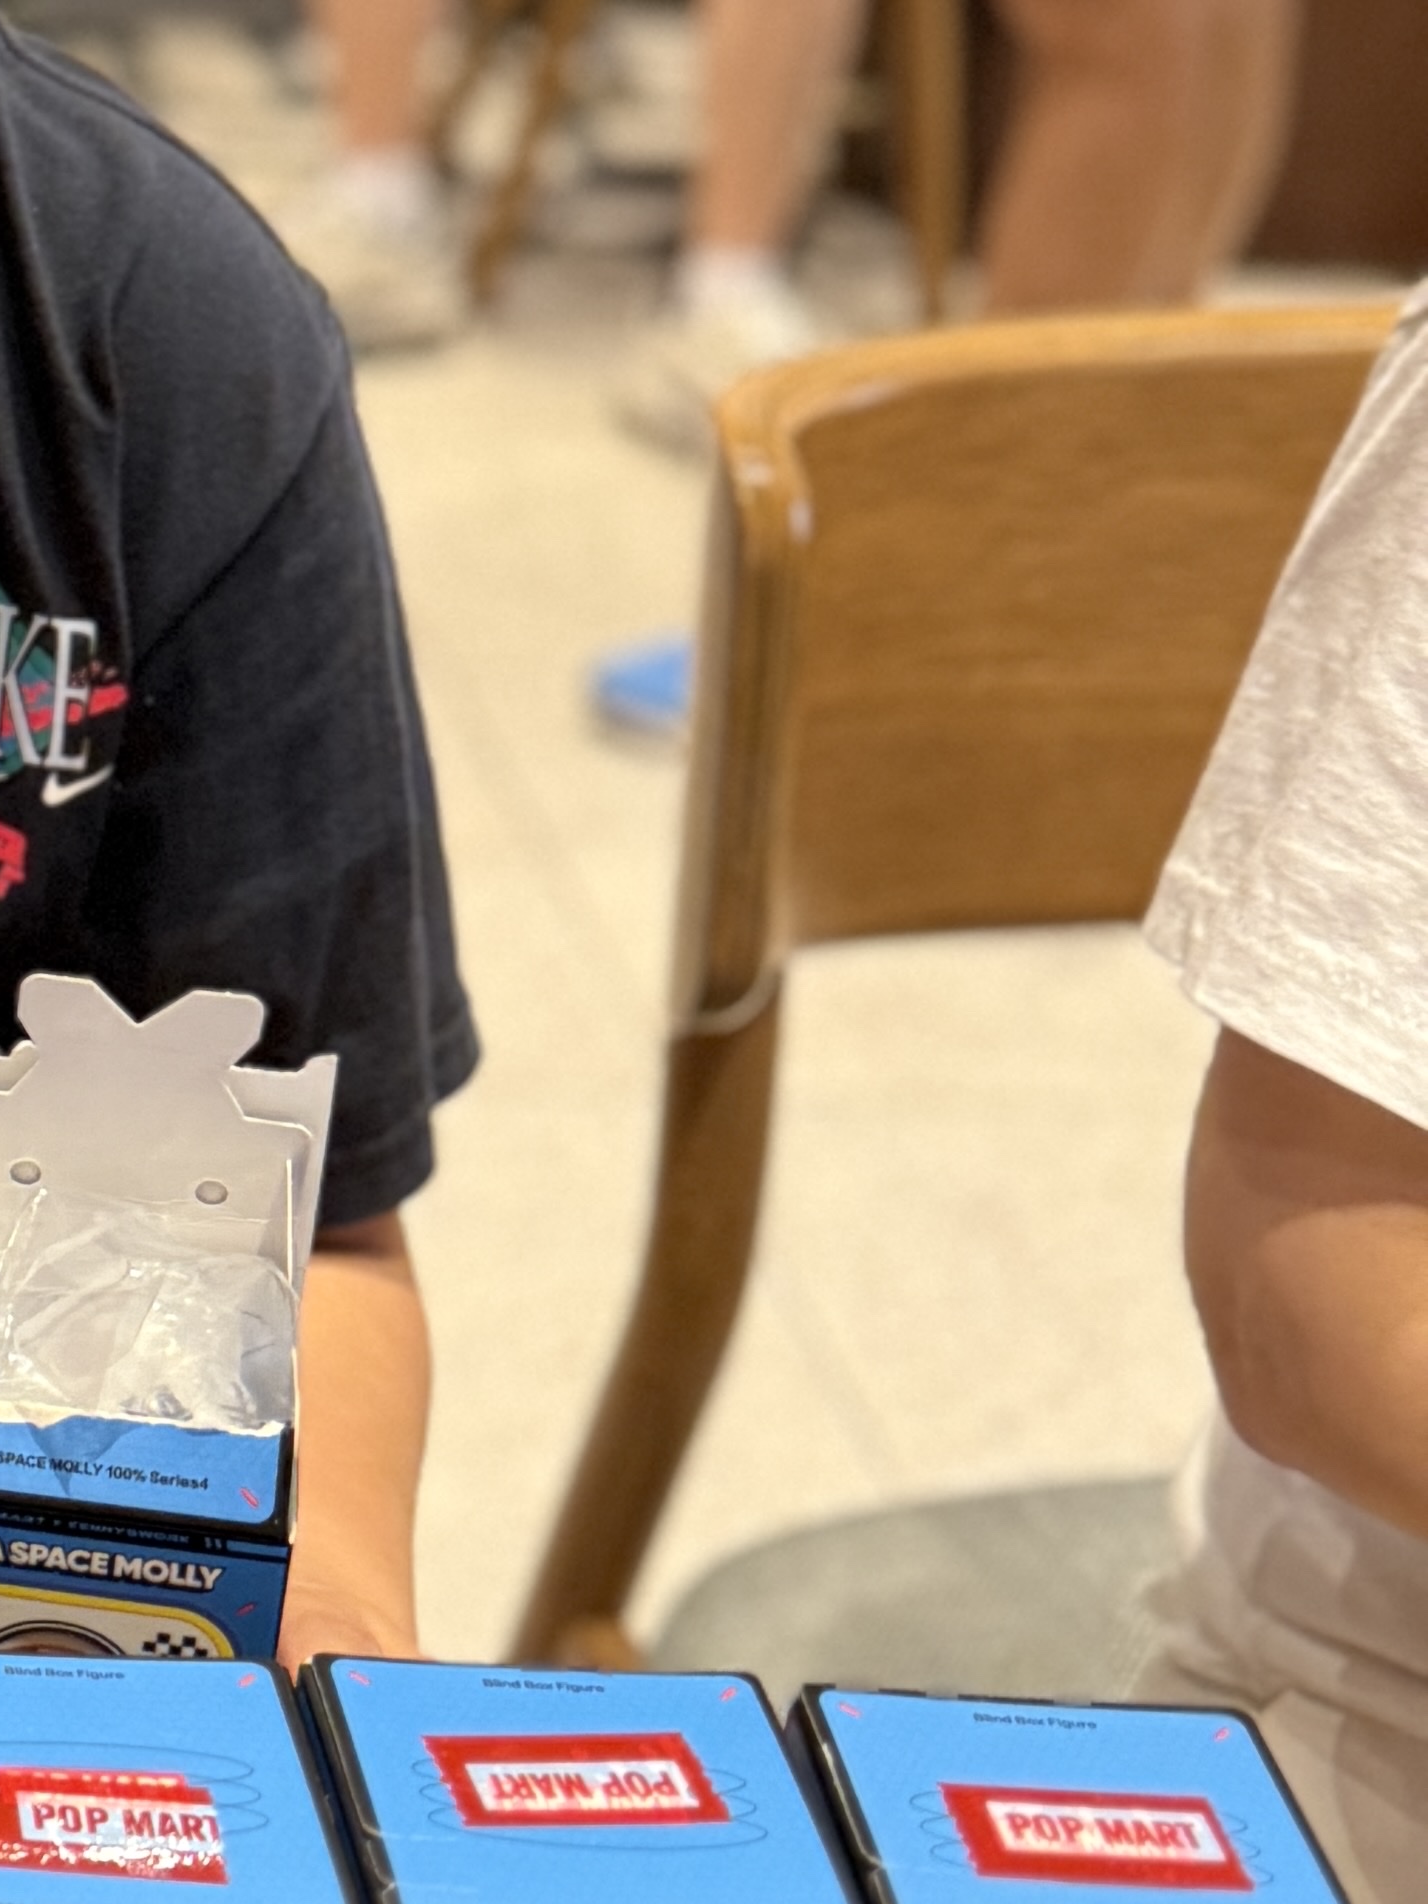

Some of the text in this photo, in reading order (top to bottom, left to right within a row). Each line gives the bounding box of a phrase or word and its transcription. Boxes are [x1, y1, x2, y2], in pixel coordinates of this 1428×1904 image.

[49, 1457, 103, 1477] MOLLY
[106, 1463, 147, 1481] 100%
[150, 1469, 209, 1490] Series4
[8, 1539, 110, 1574] SPACE
[114, 1554, 222, 1589] MOLLY
[4, 1666, 41, 1677] Blind
[489, 1771, 675, 1798] POP MART
[33, 1804, 108, 1832] POP
[1006, 1814, 1202, 1849] POP MART
